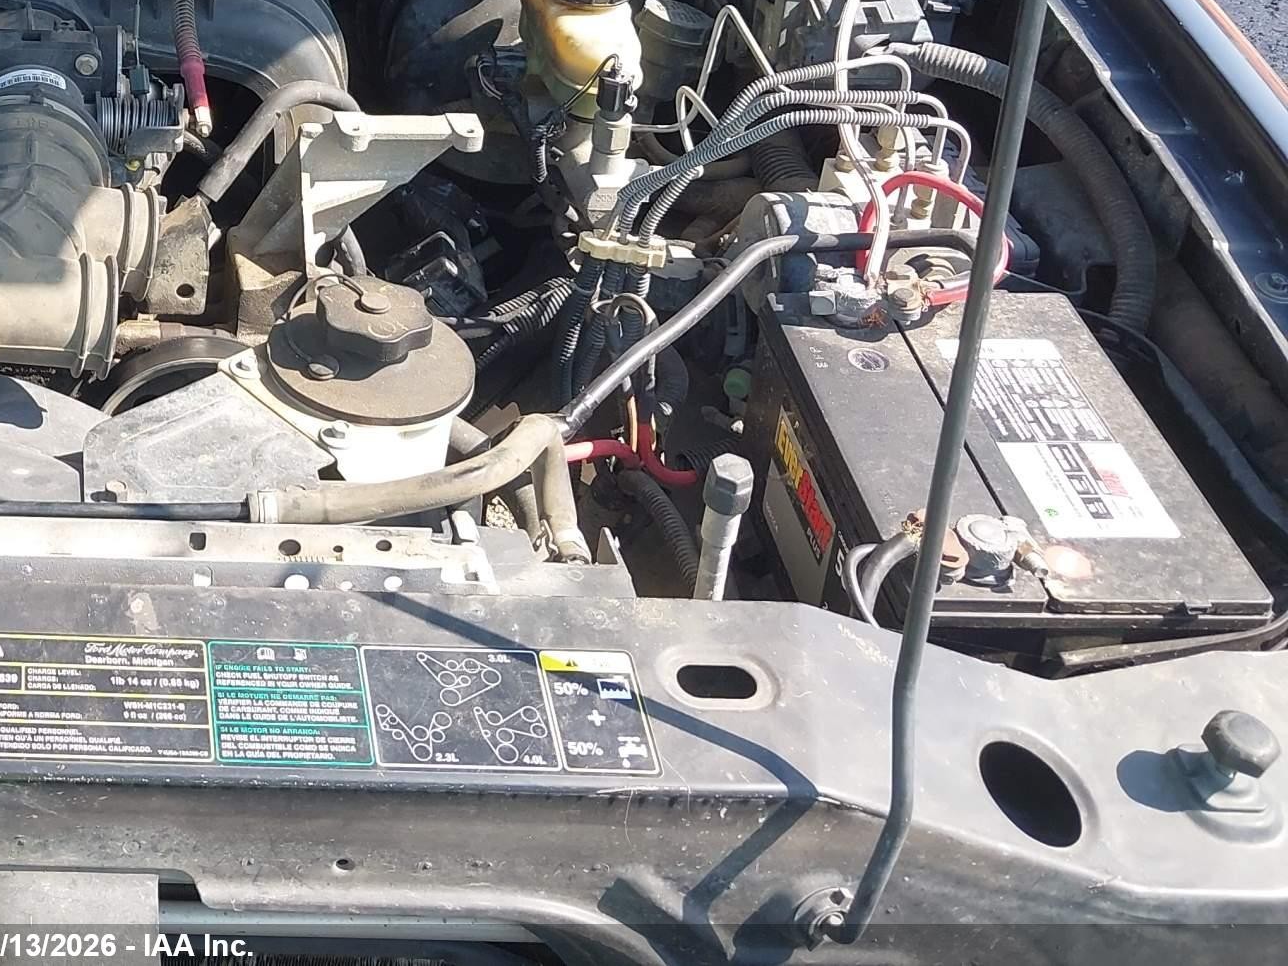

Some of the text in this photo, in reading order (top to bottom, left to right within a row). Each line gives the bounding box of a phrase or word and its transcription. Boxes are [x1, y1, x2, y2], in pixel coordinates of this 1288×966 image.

[84, 643, 111, 653] Ford
[132, 657, 174, 666] Michigan
[488, 654, 511, 664] 3.0L
[554, 682, 589, 696] 50%
[567, 741, 604, 756] 50%
[436, 753, 459, 763] 2.3L
[523, 755, 547, 765] 4.0L
